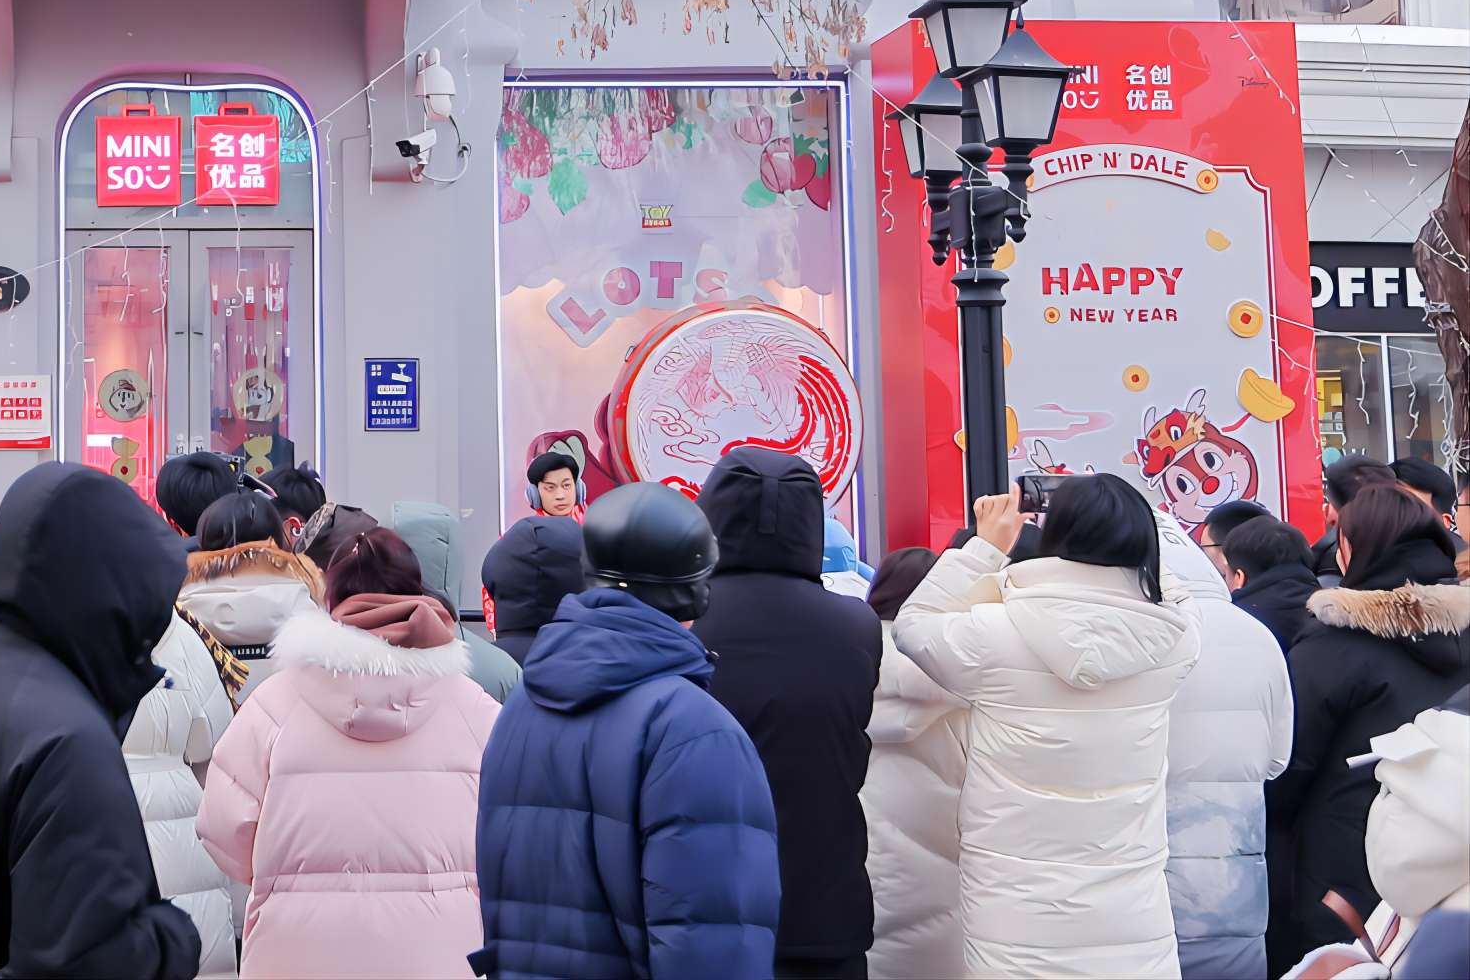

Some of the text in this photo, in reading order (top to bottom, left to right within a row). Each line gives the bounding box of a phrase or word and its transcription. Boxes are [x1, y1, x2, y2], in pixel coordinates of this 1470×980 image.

[1125, 64, 1172, 85] 名创
[1125, 89, 1173, 111] 优品
[106, 134, 171, 158] MINI
[209, 132, 265, 158] 名创
[208, 163, 265, 189] 优品
[1043, 152, 1094, 177] CHIP
[1130, 152, 1189, 179] DALE
[1041, 262, 1184, 296] HAPPY
[1069, 307, 1178, 323] NEW YEAR
